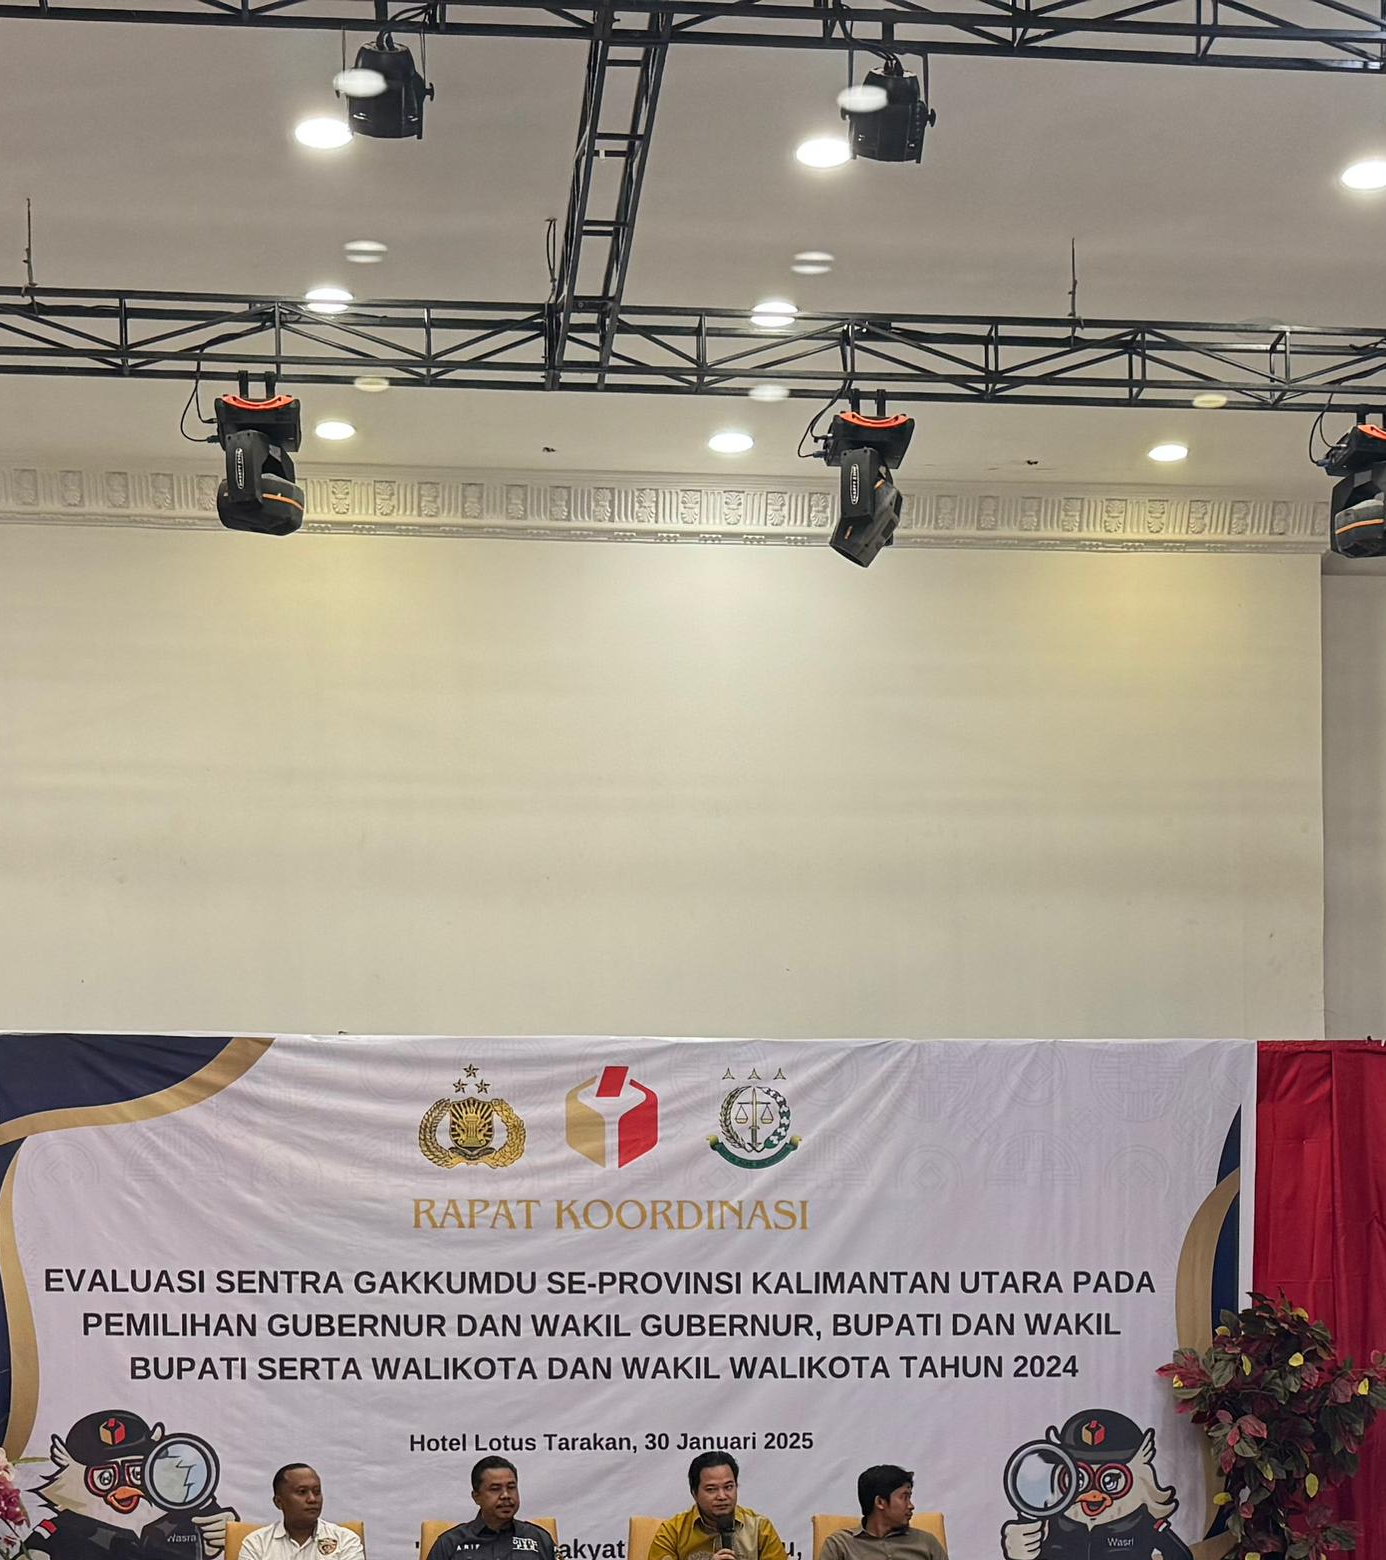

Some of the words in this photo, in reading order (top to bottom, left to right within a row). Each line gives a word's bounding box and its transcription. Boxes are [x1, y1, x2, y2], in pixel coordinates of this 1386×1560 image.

[413, 1198, 540, 1229] RAPAT
[556, 1199, 809, 1232] KOORDINASI
[46, 1269, 206, 1294] EVALUASI
[217, 1270, 345, 1295] SENTRA
[354, 1271, 538, 1295] GAKKUMDU
[548, 1272, 742, 1296] SE-PROVINSI
[753, 1272, 951, 1296] KALIMANTAN
[961, 1272, 1064, 1295] UTARA
[1074, 1271, 1157, 1295] PADA
[84, 1313, 258, 1338] PEMILIHAN
[268, 1314, 447, 1338] GUBERNUR
[458, 1315, 522, 1338] DAN
[531, 1315, 632, 1338] WAKIL
[641, 1314, 823, 1342] GUBERNUR,
[833, 1314, 942, 1338] BUPATI
[953, 1314, 1016, 1337] DAN
[1025, 1313, 1122, 1337] WAKIL
[131, 1357, 248, 1381] BUPATI
[258, 1358, 363, 1382] SERTA
[372, 1358, 539, 1381] WALIKOTA
[549, 1357, 613, 1381] DAN
[622, 1357, 722, 1381] WAKIL
[730, 1356, 891, 1380] WALIKOTA
[900, 1356, 1004, 1380] TAHUN
[1014, 1356, 1080, 1379] 2024
[410, 1434, 468, 1453] Hotel
[475, 1434, 538, 1453] Lotus
[543, 1433, 638, 1456] Tarakan,
[644, 1433, 671, 1453] 30
[676, 1432, 757, 1451] Januari
[764, 1432, 815, 1451] 2025
